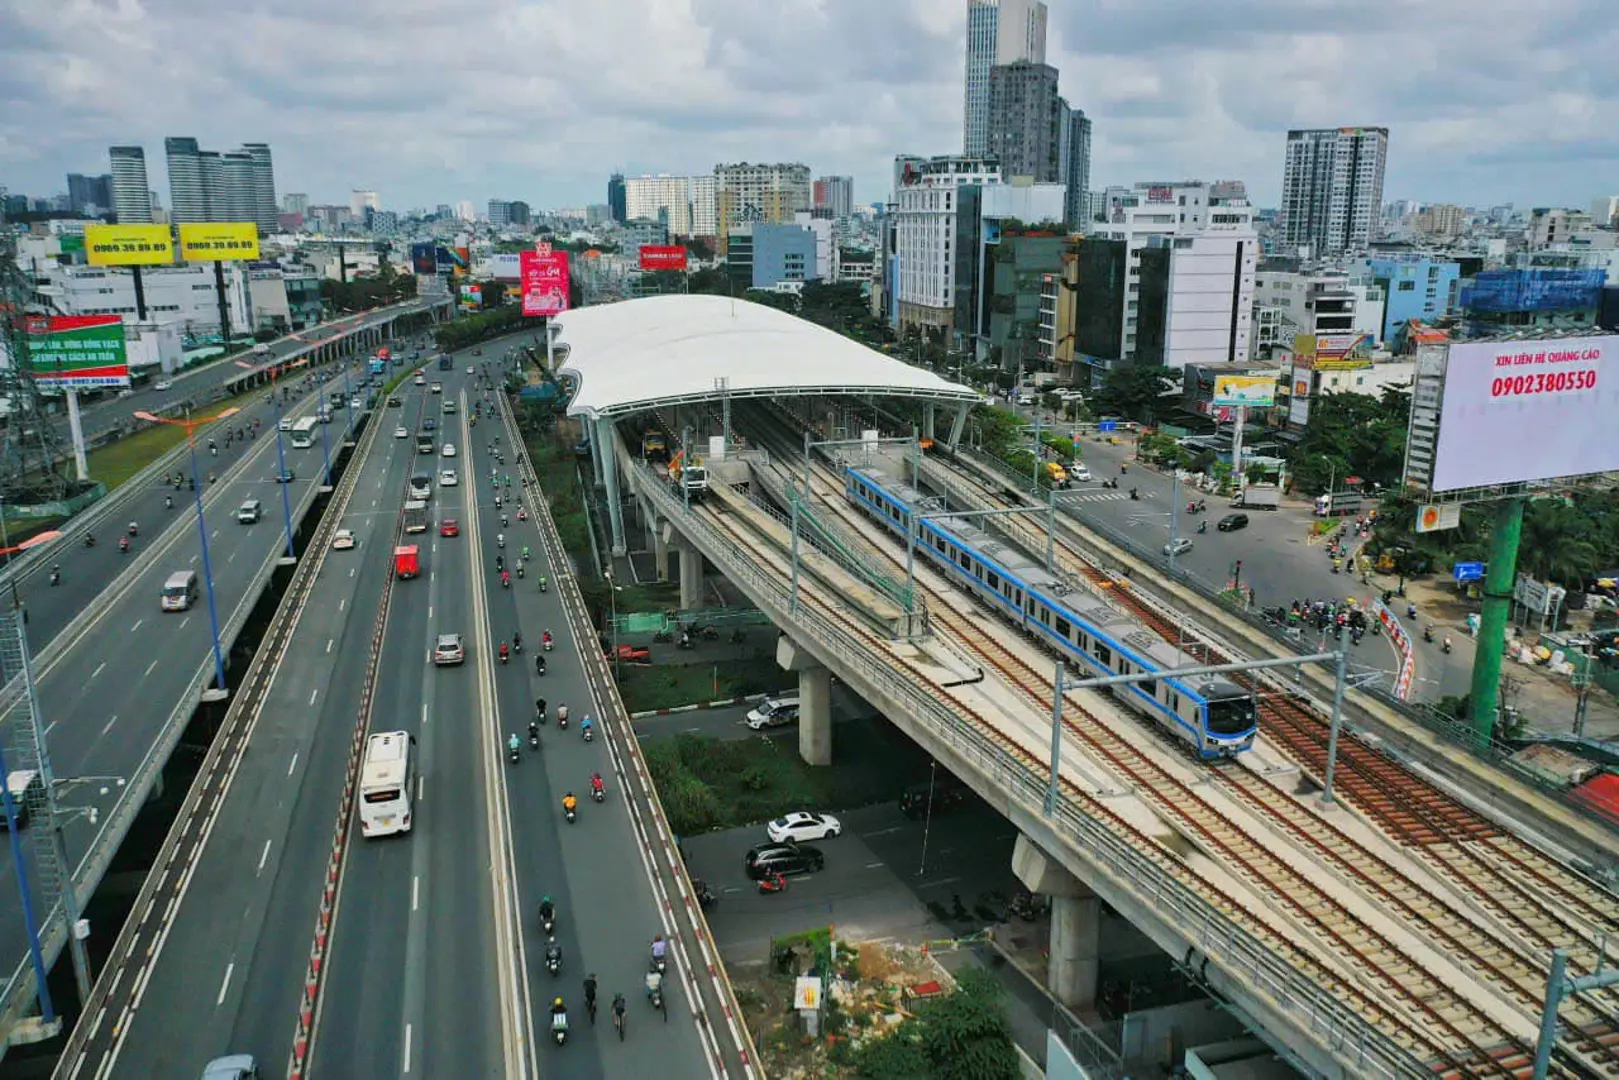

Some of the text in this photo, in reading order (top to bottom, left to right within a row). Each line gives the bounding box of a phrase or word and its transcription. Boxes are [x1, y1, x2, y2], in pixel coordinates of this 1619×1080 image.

[1496, 355, 1512, 366] XIN
[1514, 353, 1533, 365] LIÊN
[1548, 349, 1580, 363] QUẢNG
[1581, 349, 1600, 360] CÁO
[1492, 370, 1596, 396] 0902380550
